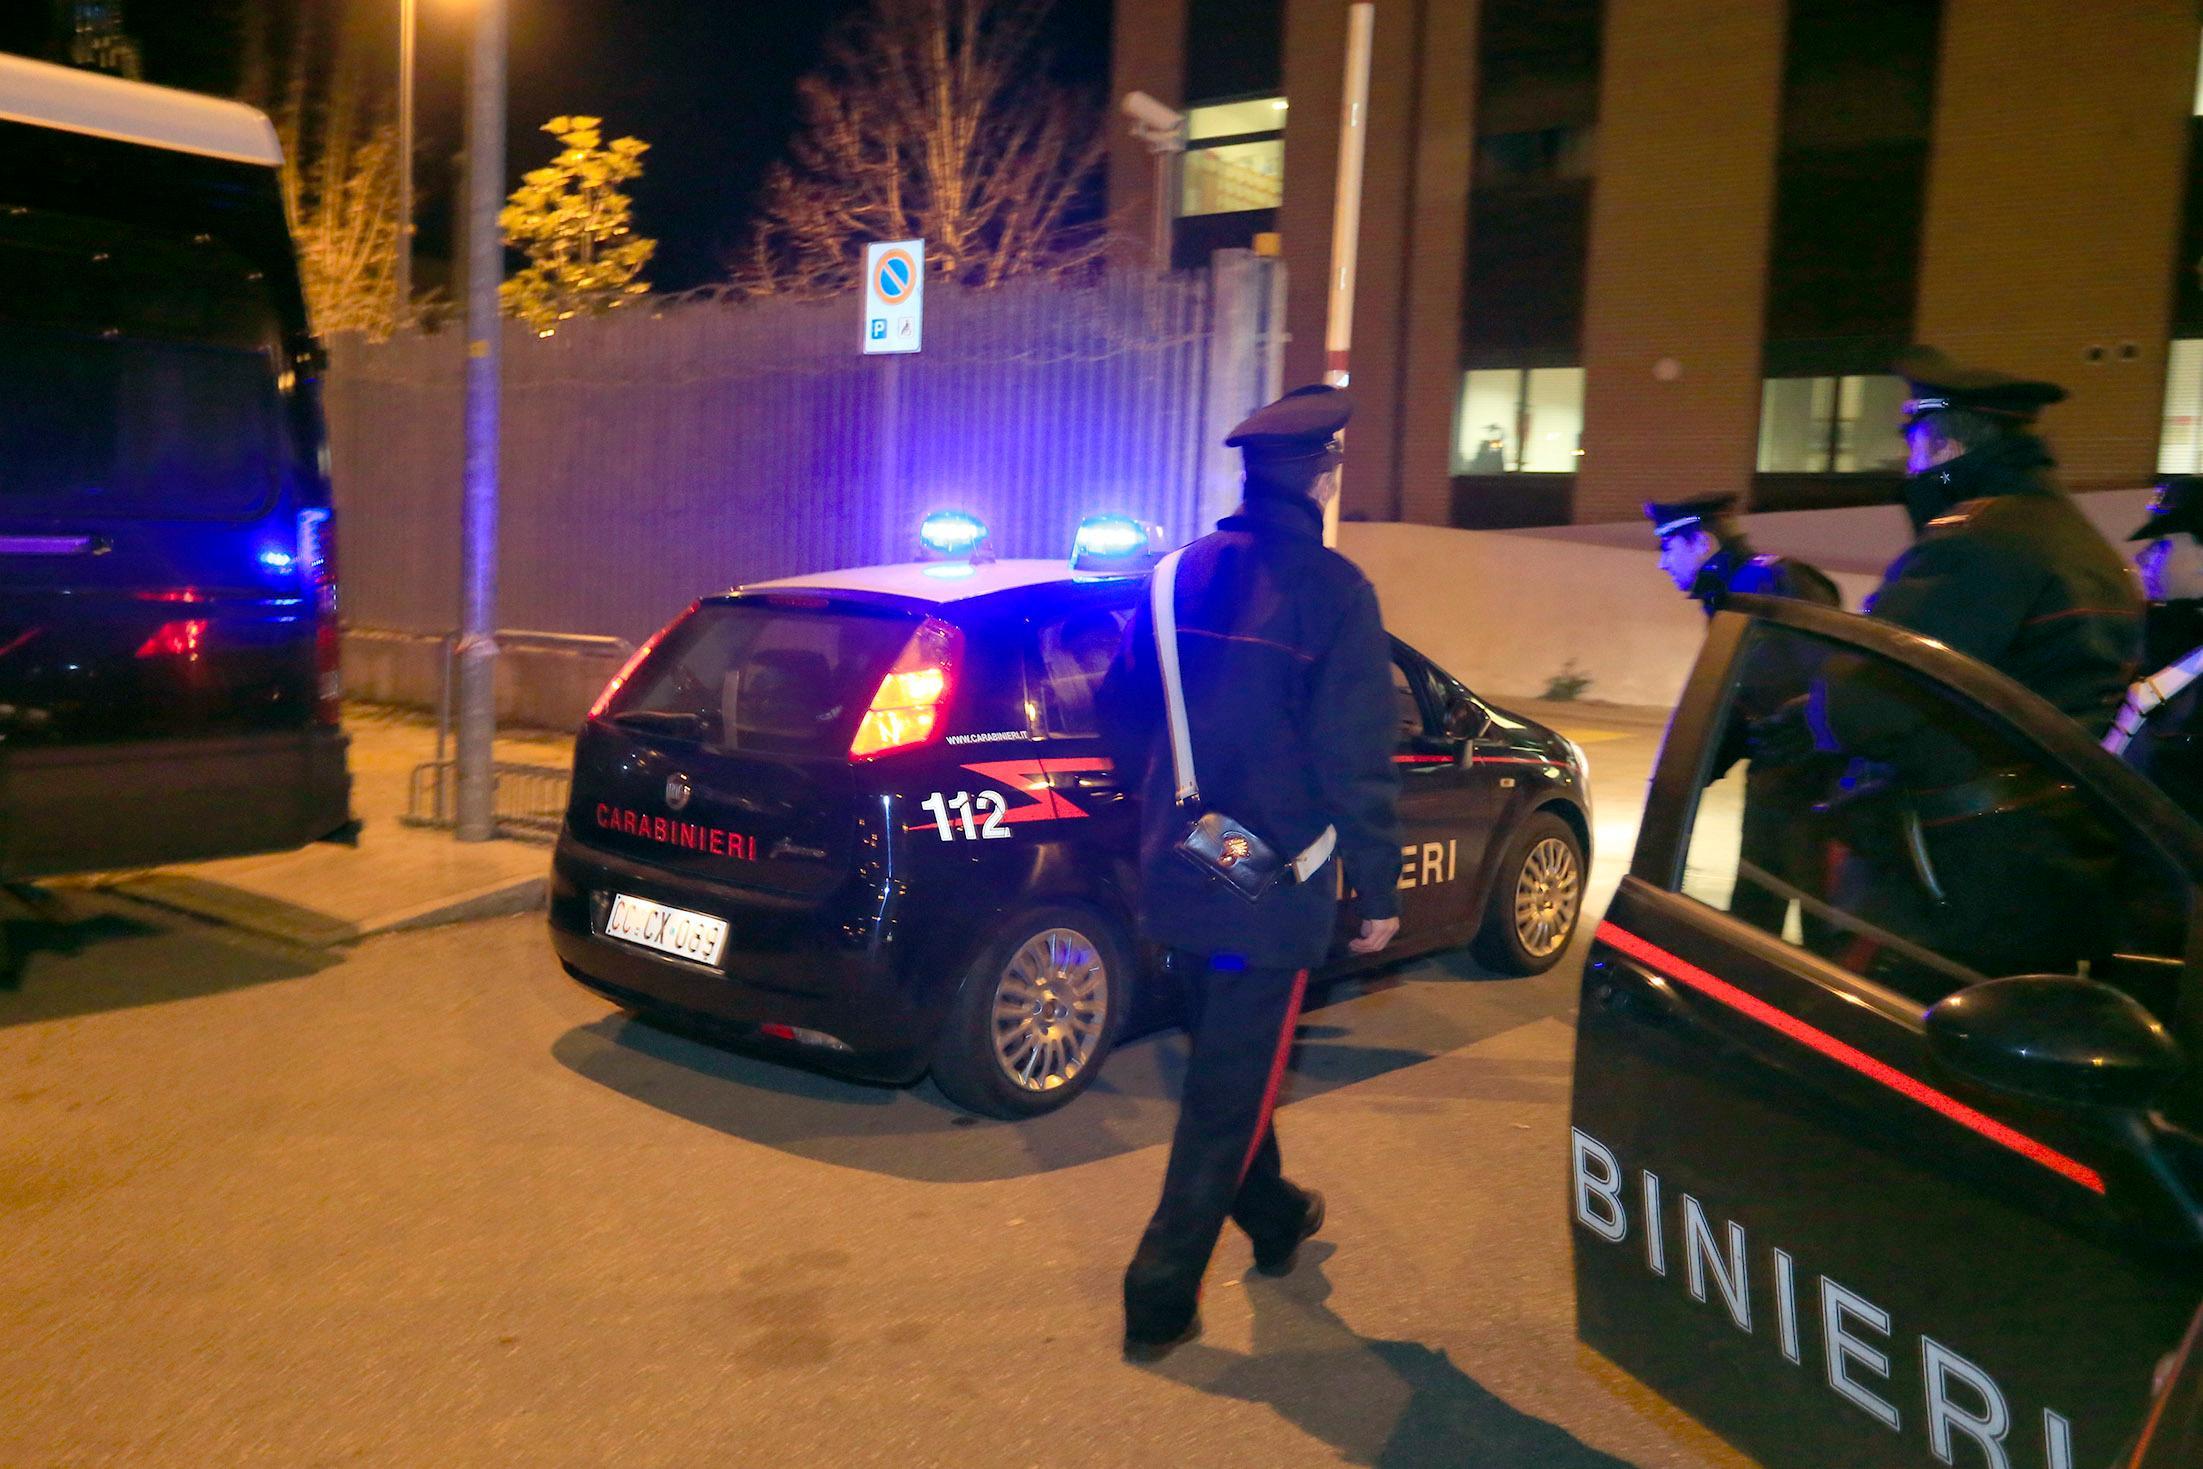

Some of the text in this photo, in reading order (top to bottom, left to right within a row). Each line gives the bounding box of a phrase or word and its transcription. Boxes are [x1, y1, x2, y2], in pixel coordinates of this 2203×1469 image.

[873, 320, 886, 338] P
[945, 730, 1028, 746] WWW.CARABINIERI.IT
[596, 803, 756, 862] CARABINIERI
[921, 790, 1012, 842] 112
